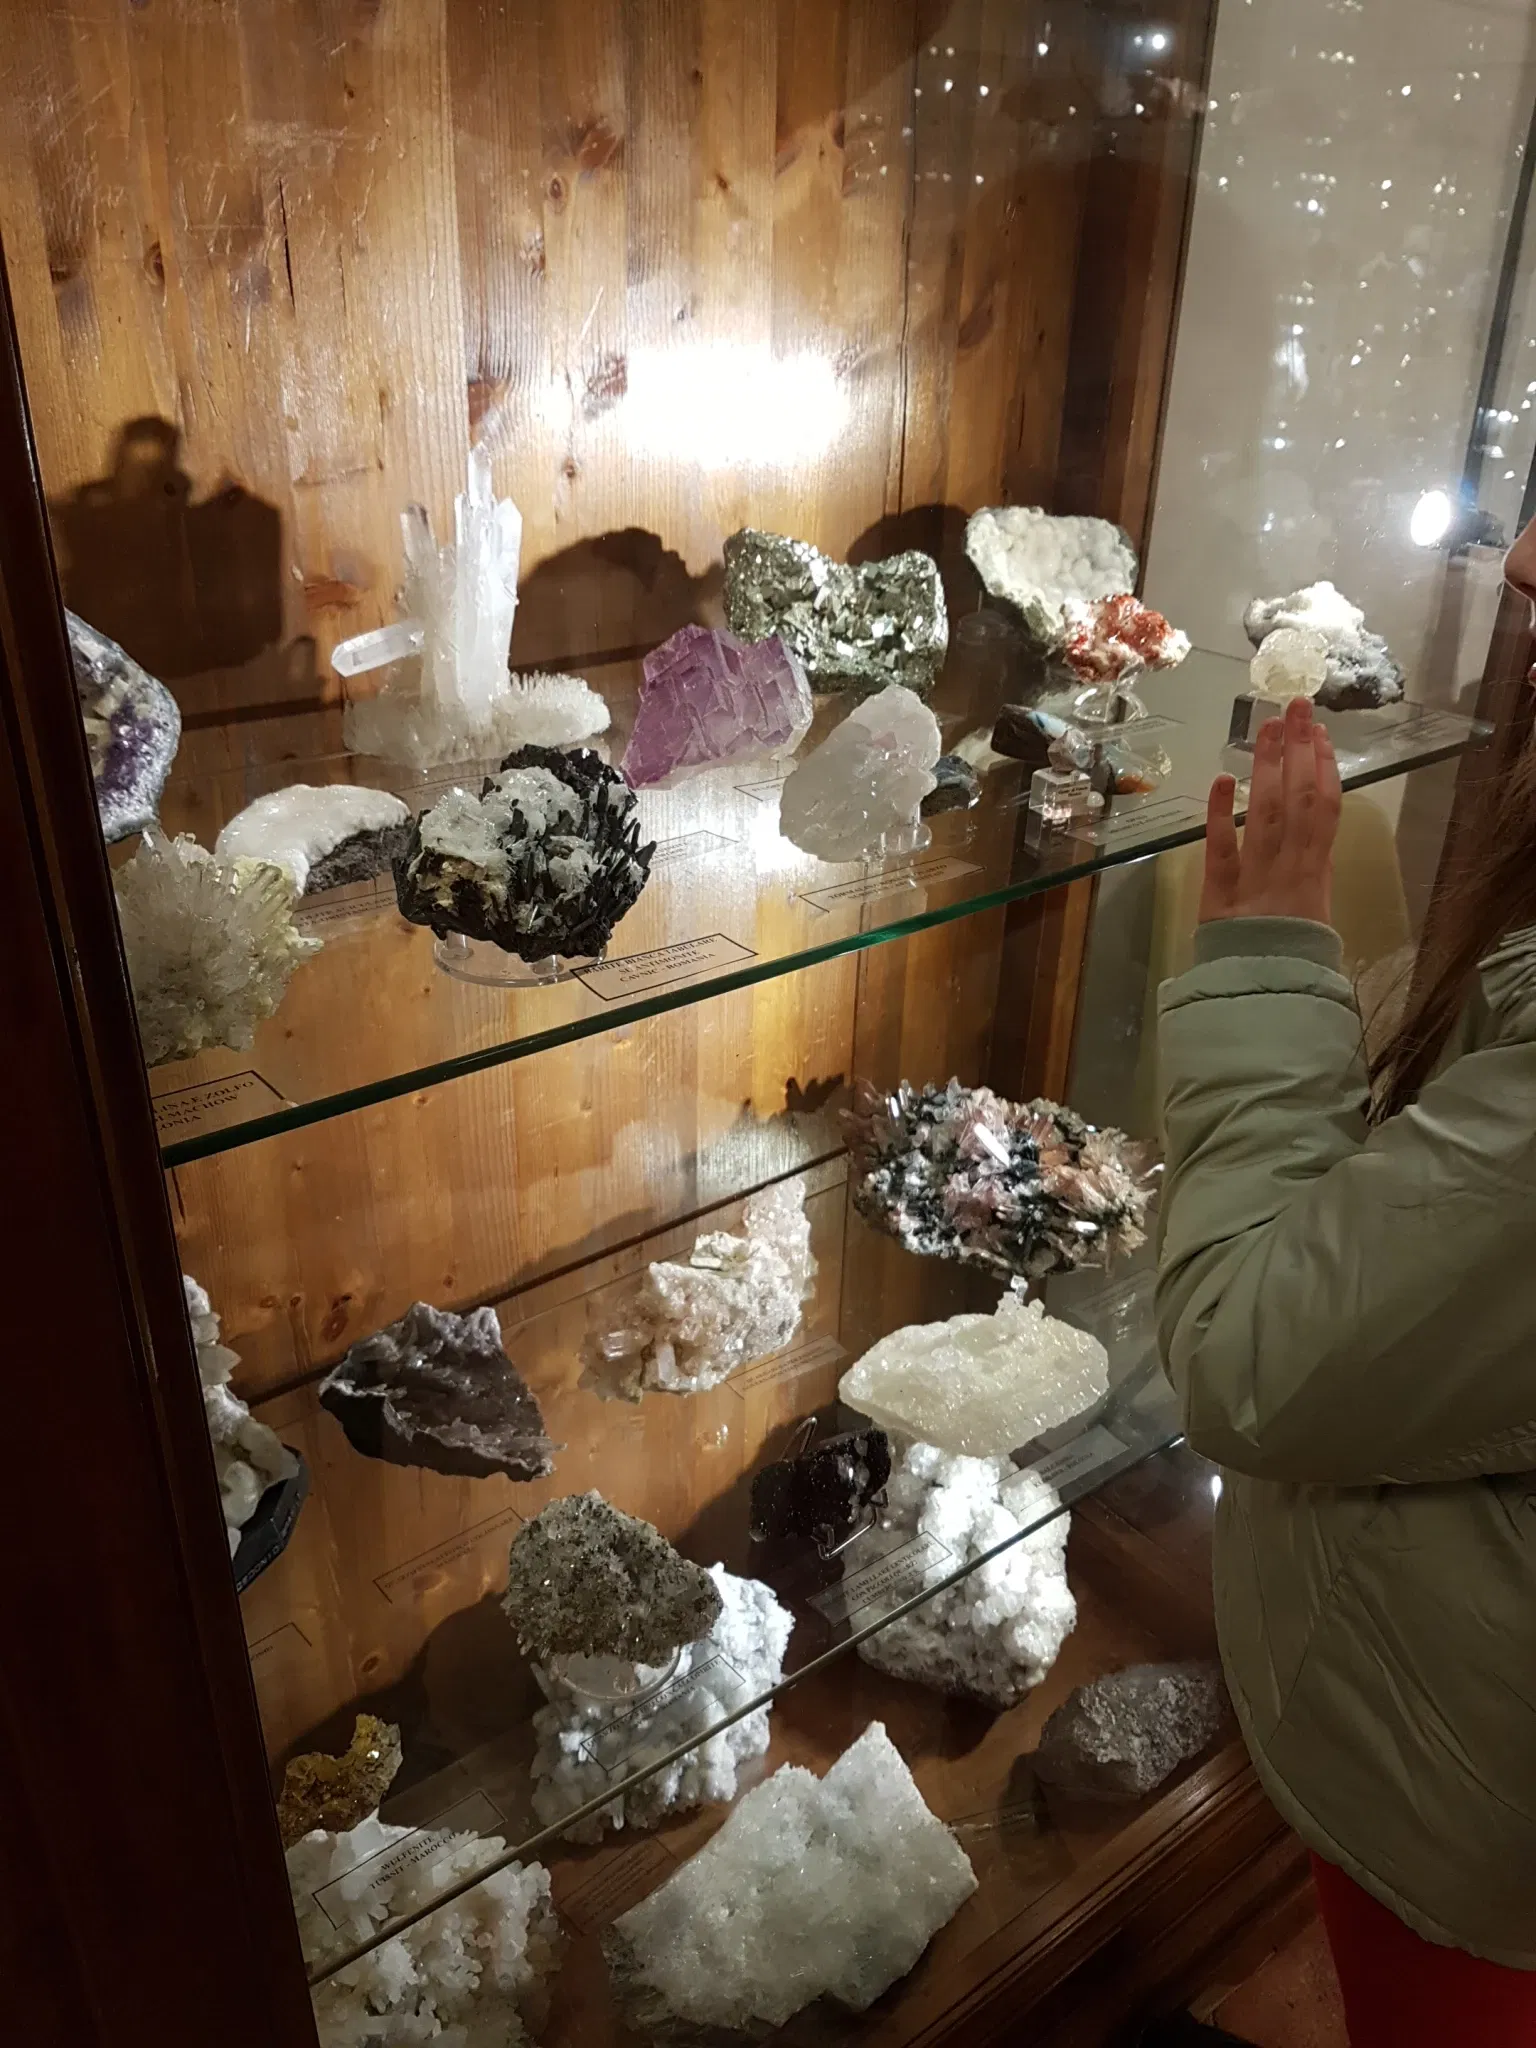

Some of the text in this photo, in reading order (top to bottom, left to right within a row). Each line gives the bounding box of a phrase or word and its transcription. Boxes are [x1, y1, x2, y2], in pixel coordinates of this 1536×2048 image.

[583, 937, 718, 975] BARITE BIANCA TABULARE
[618, 949, 700, 976] SU ANTIMONITE
[619, 969, 660, 983] CAVNIC
[667, 952, 716, 970] ROMANIA
[167, 1094, 239, 1118] MACHOW
[205, 1081, 254, 1100] ZOLFO
[381, 1836, 435, 1870] WULFENITE
[410, 1831, 458, 1864] MAROCCO
